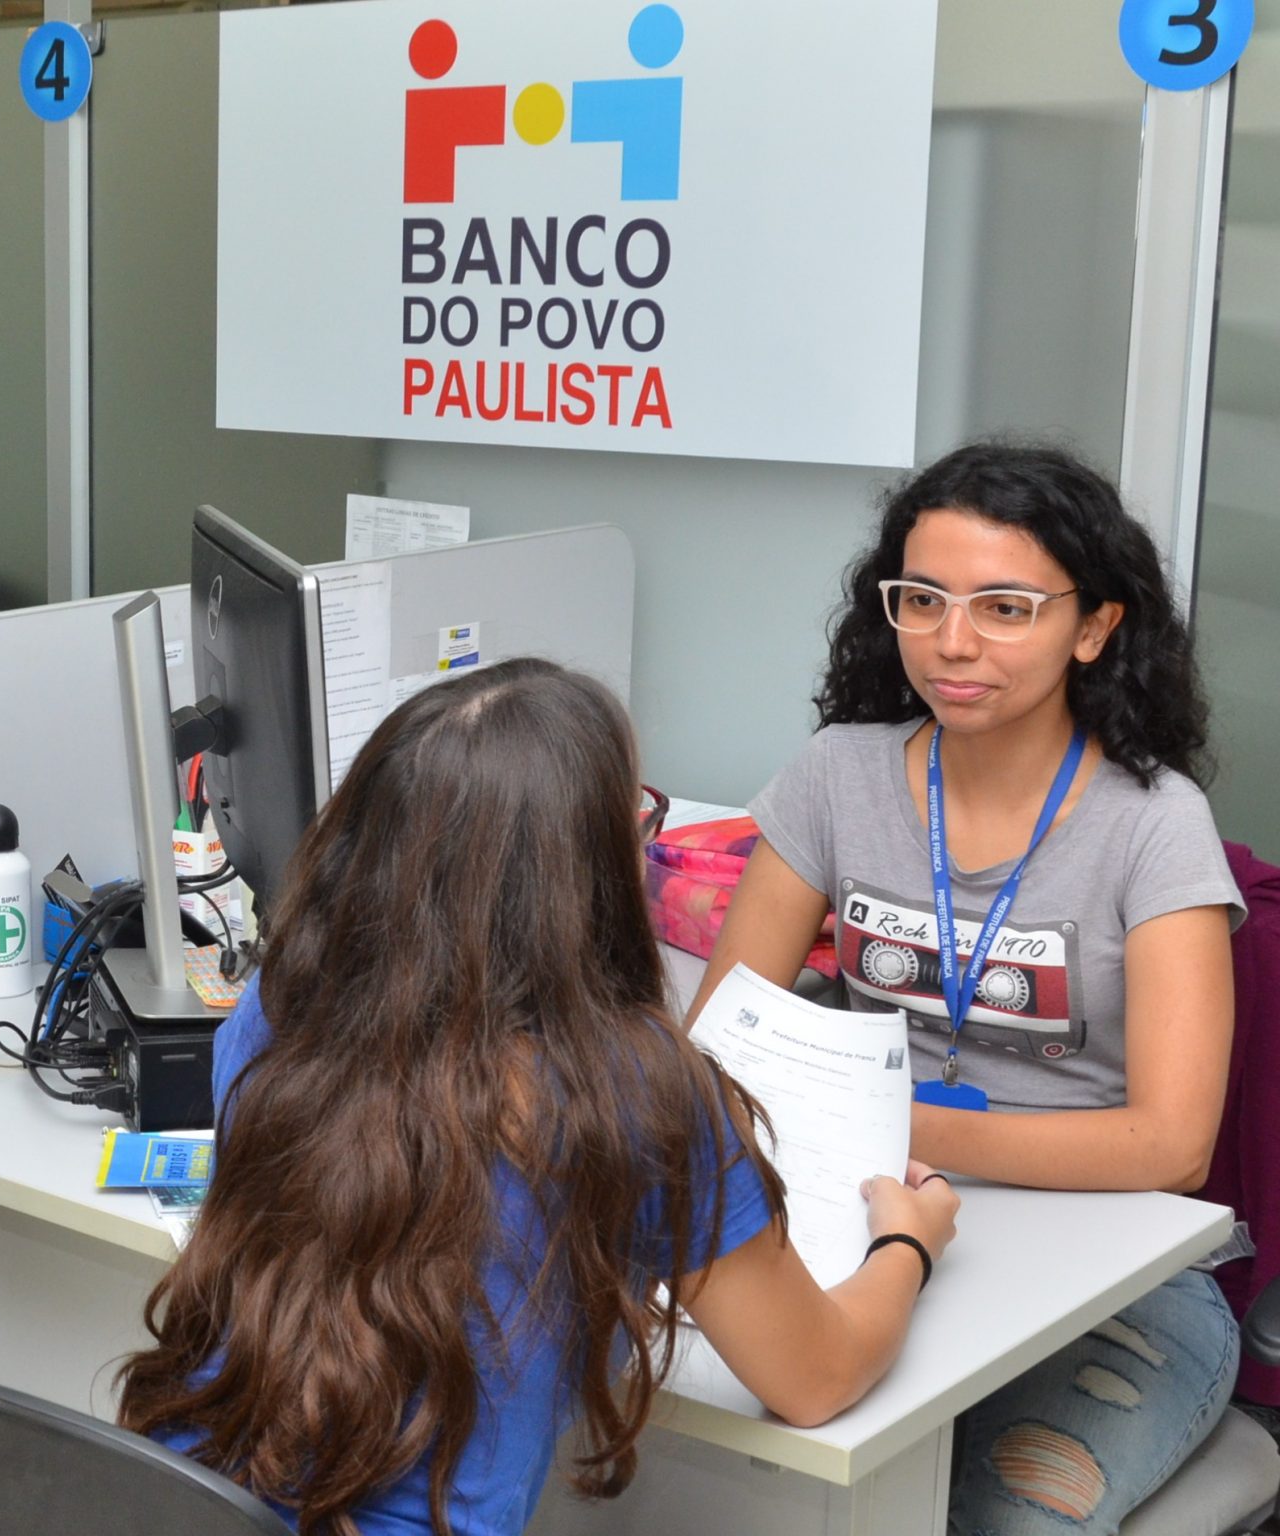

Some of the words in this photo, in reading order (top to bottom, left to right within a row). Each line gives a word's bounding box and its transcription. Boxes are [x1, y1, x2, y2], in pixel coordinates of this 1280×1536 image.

[1158, 0, 1219, 66] 3
[34, 38, 70, 101] 4
[402, 214, 671, 289] BANCO
[402, 295, 479, 347] DO
[500, 297, 665, 352] POVO
[403, 358, 673, 429] PAULISTA
[929, 785, 940, 831] PREFEITURA
[931, 831, 941, 842] DE
[932, 843, 944, 873] FRANCA
[851, 905, 864, 921] A
[936, 889, 950, 936] PREFEITURA
[987, 896, 1011, 938] PREFEITURA
[876, 911, 929, 940] Rock
[996, 935, 1047, 958] 1970
[940, 936, 951, 947] DE
[980, 938, 990, 950] DE
[943, 947, 954, 979] FRANCA
[969, 948, 985, 979] FRANCA
[771, 1029, 808, 1047] Prefeitura
[809, 1043, 843, 1056] Municipal
